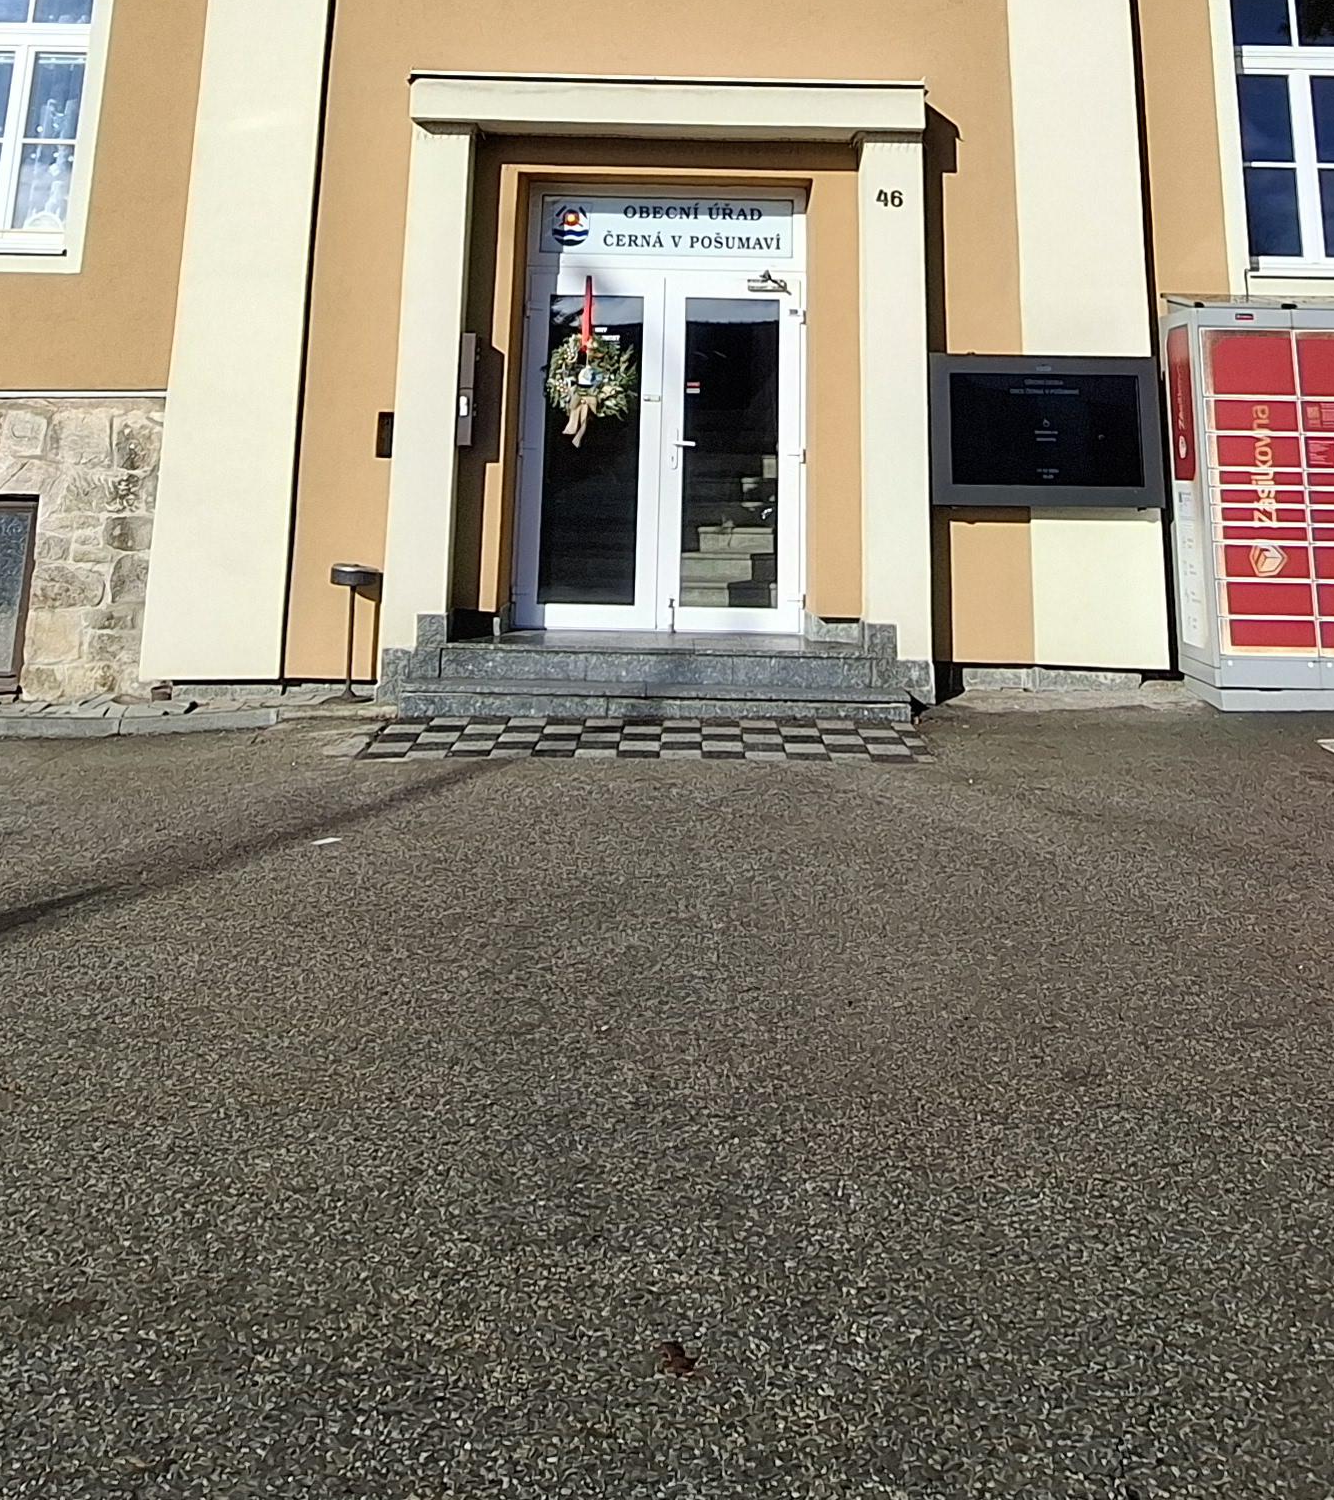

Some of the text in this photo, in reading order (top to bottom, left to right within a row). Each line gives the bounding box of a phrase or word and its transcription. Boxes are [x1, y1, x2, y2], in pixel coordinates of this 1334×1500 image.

[876, 189, 904, 207] 46
[623, 202, 763, 221] OBECNÍ ÚŘAD
[603, 230, 781, 250] ČERNÁ V POŠUMAVÍ
[1250, 404, 1278, 528] Zásilkovna
